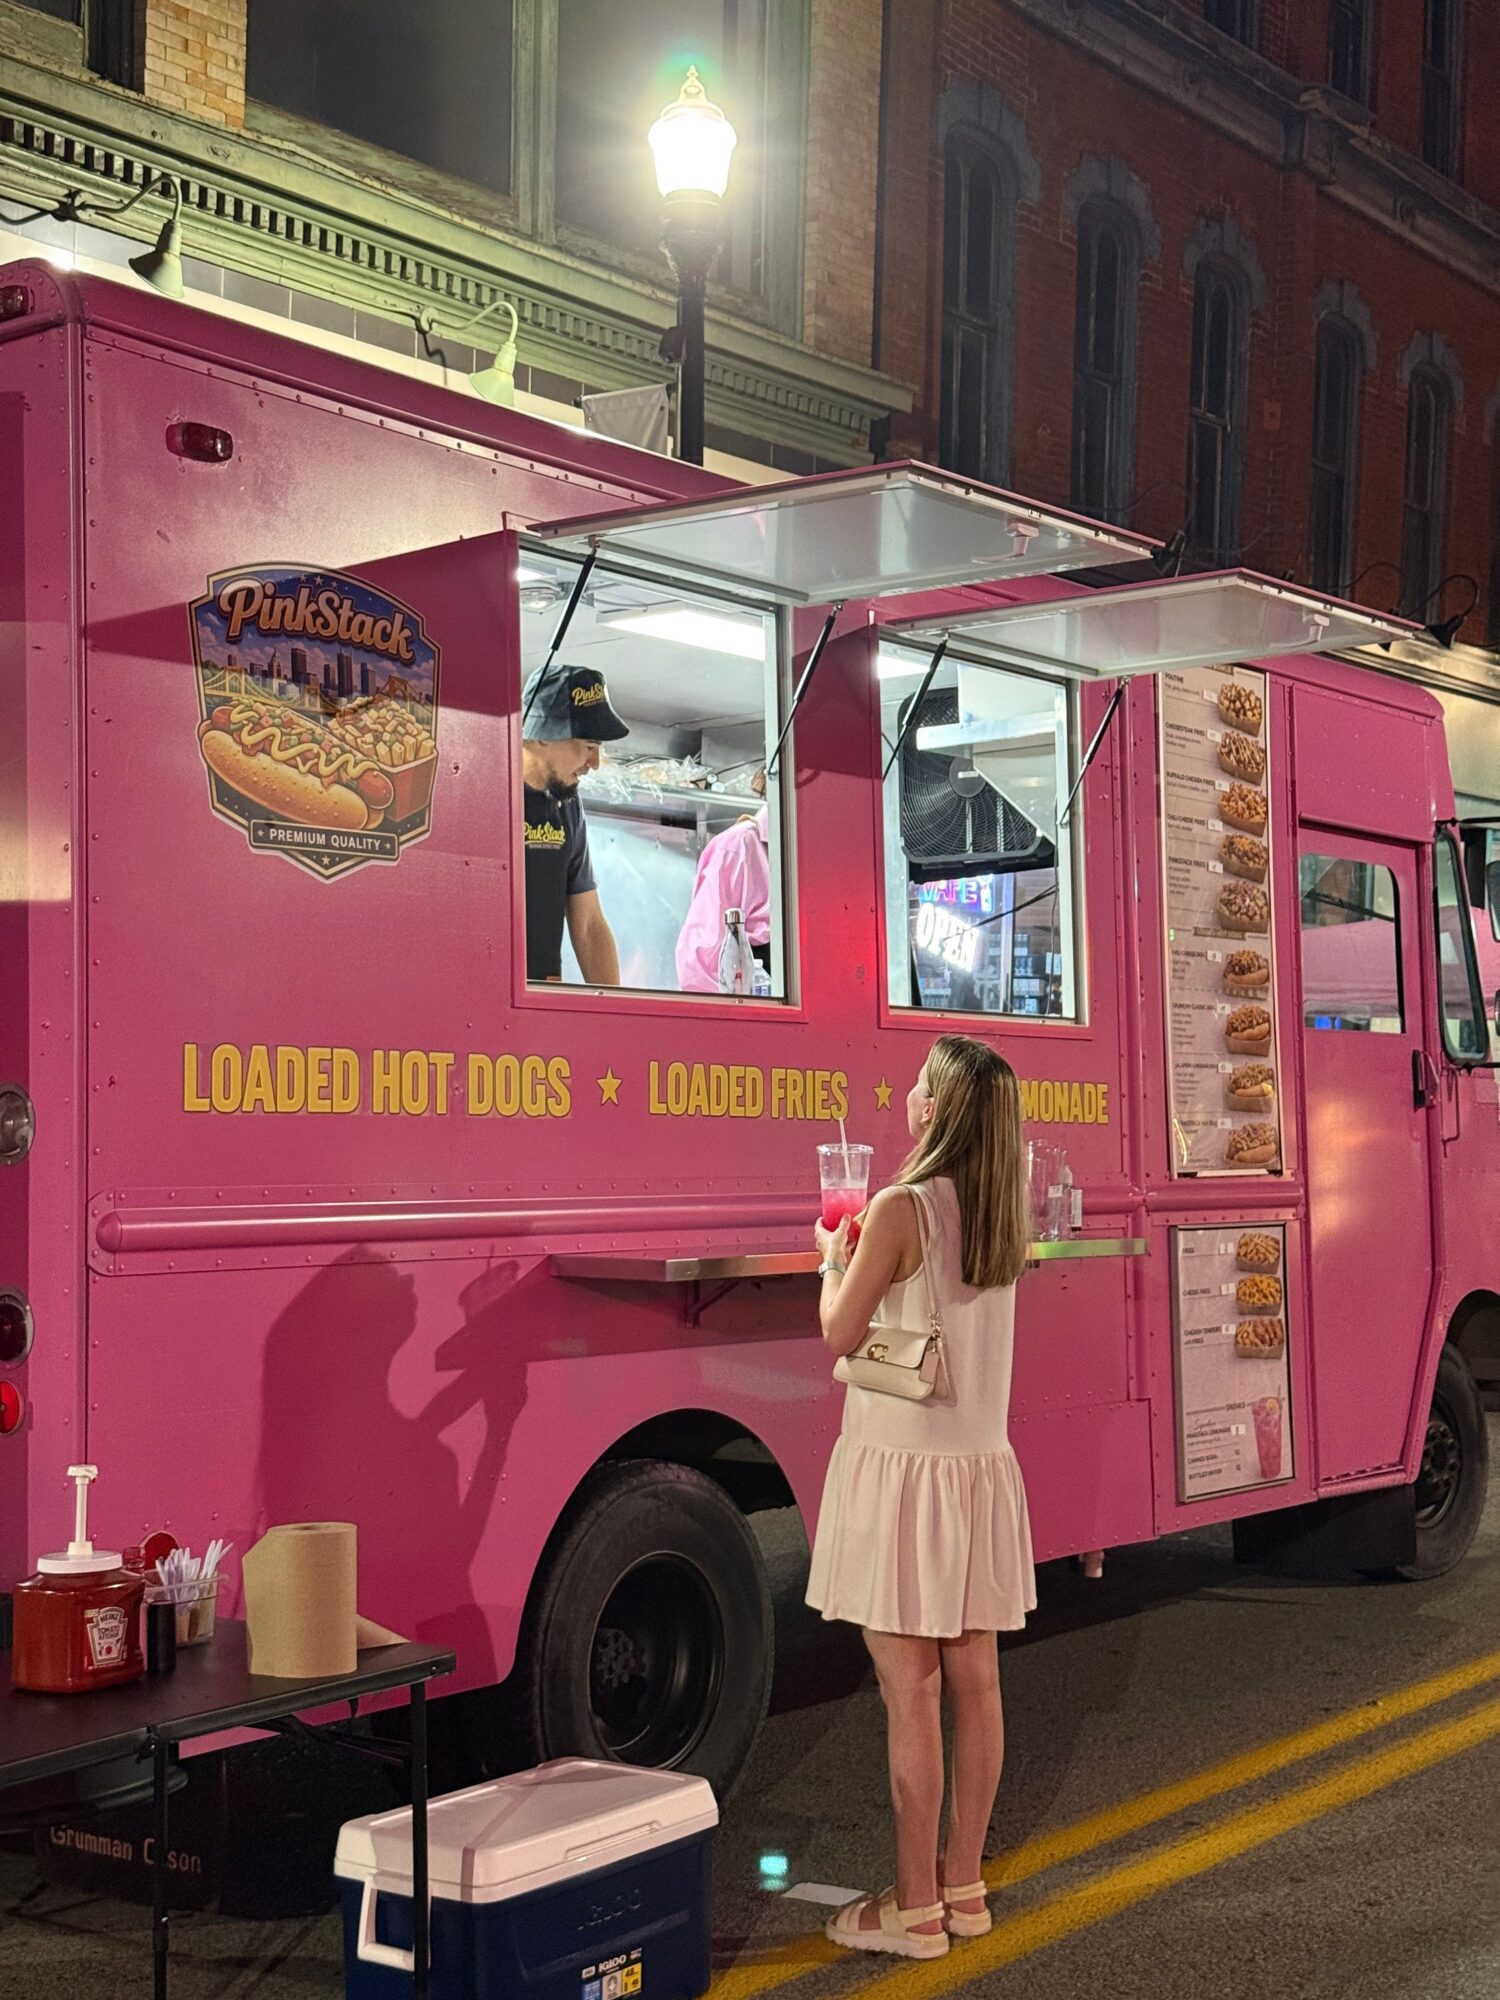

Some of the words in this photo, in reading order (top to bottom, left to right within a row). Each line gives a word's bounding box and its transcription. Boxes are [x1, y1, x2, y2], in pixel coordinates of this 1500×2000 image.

[219, 577, 414, 658] PinkStack
[269, 829, 326, 845] PREMIUM
[331, 834, 381, 851] QUALITY
[917, 902, 980, 973] OPEN
[183, 1042, 360, 1114] LOADED
[372, 1049, 455, 1115] HOT
[467, 1052, 572, 1118] DOGS
[648, 1060, 764, 1117] LOADED
[771, 1067, 848, 1121] FRIES
[1018, 1079, 1109, 1125] MONADE
[100, 1612, 119, 1623] HEINZ
[50, 1825, 133, 1861] Grumman
[599, 1954, 627, 1972] IGLOO
